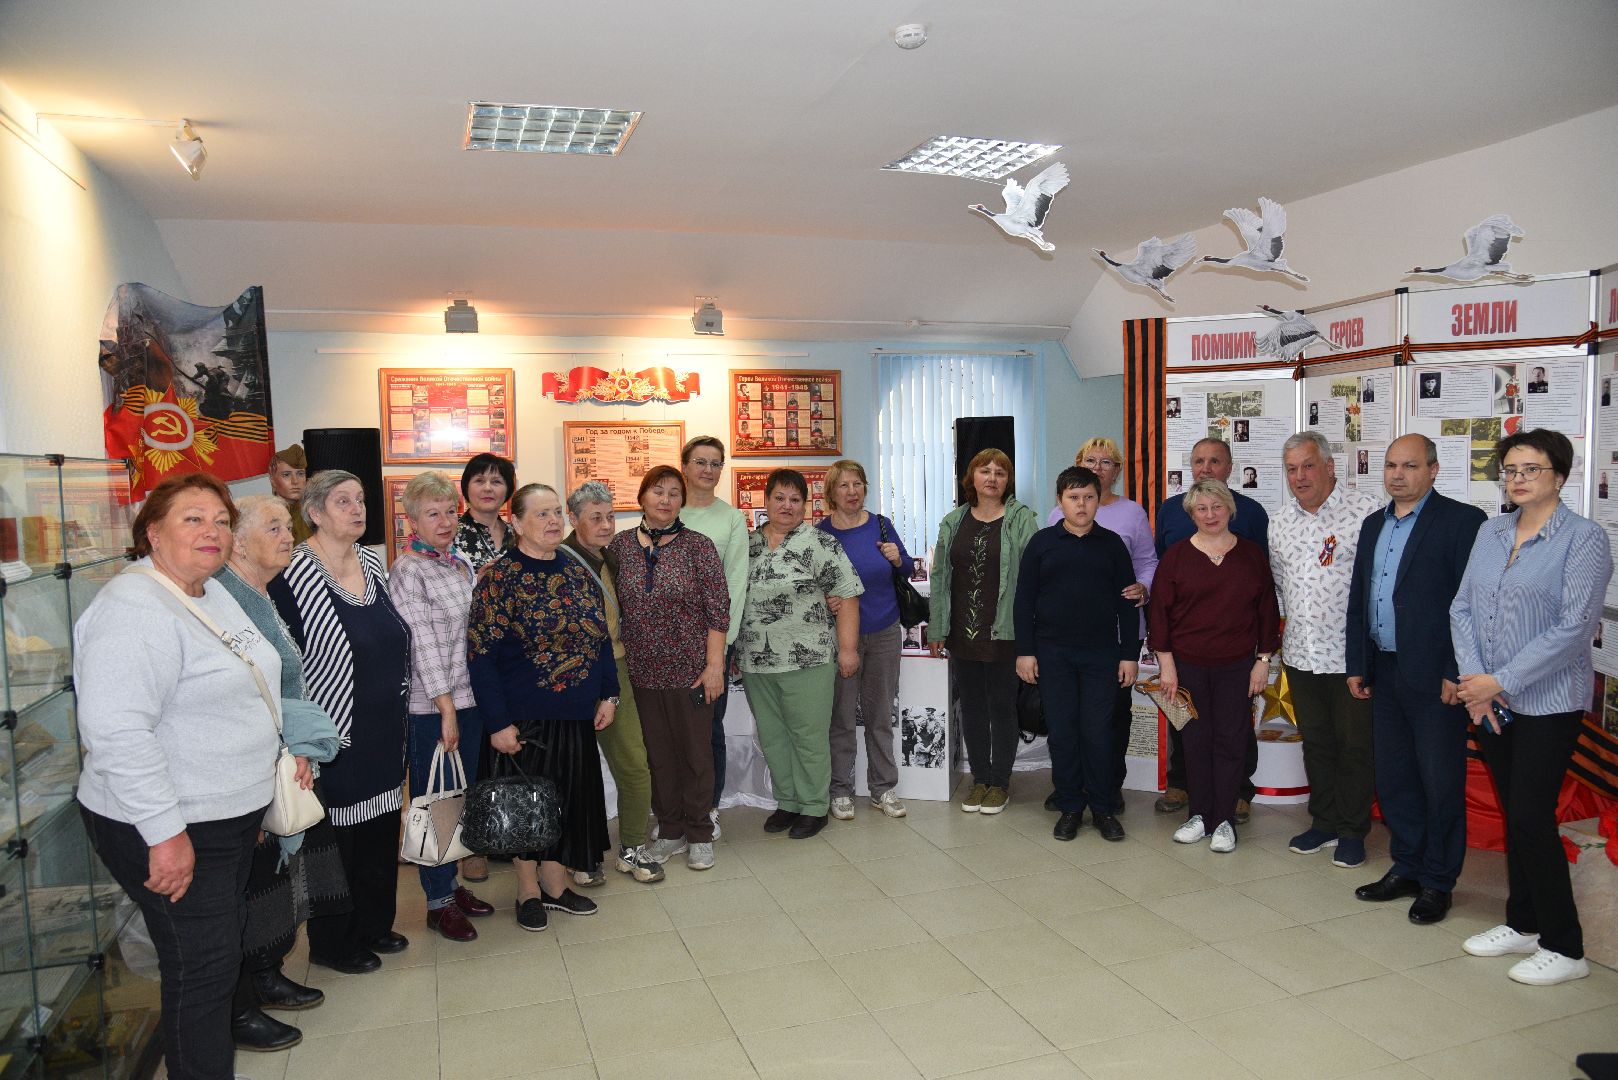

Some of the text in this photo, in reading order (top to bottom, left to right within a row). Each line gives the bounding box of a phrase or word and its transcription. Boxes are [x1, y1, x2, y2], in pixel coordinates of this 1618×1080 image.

[1329, 317, 1364, 351] ГЕРОЕВ
[1451, 300, 1518, 336] ЗЕМЛИ
[1191, 331, 1256, 361] ПОМНИМ
